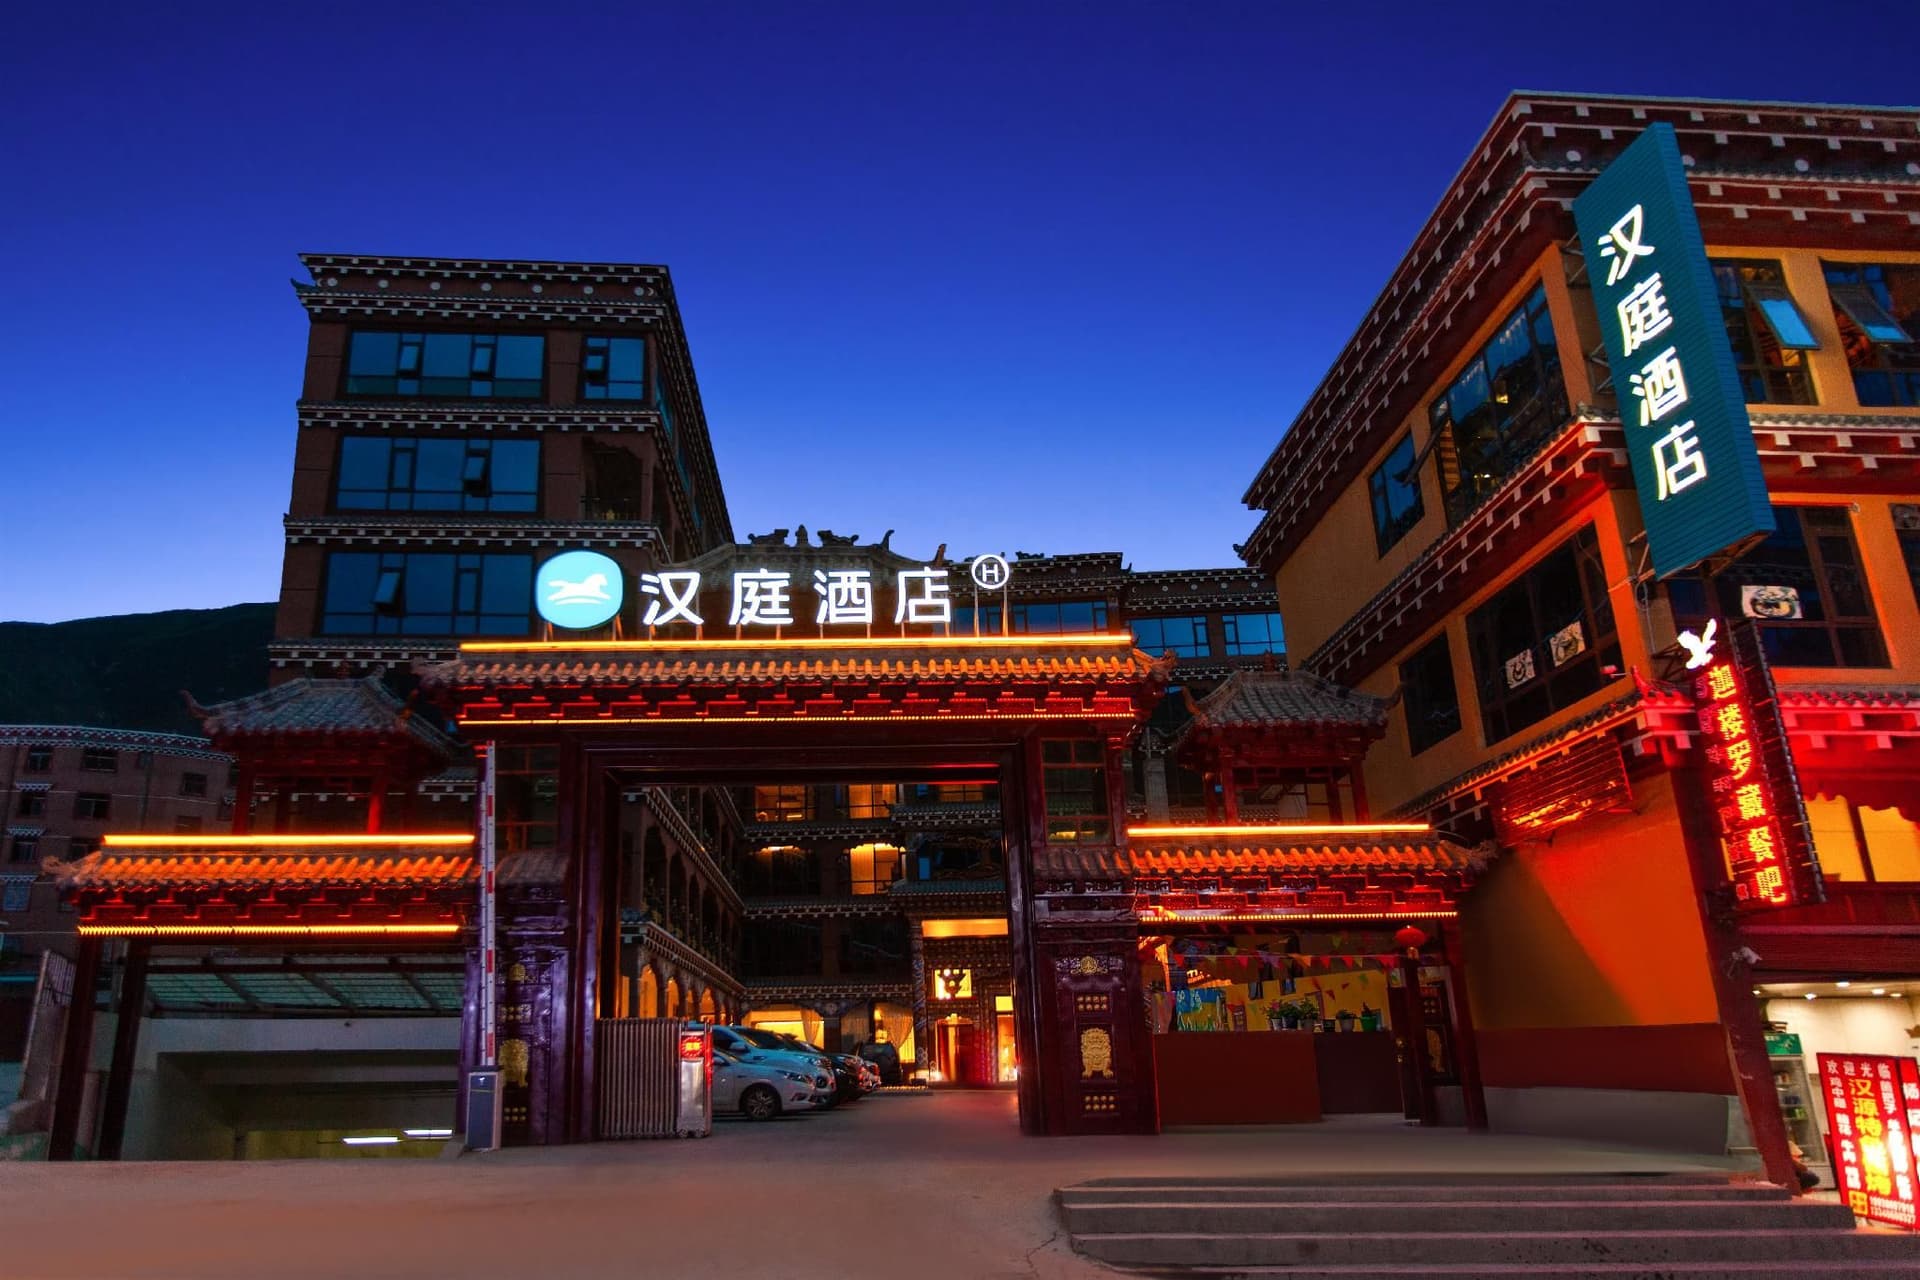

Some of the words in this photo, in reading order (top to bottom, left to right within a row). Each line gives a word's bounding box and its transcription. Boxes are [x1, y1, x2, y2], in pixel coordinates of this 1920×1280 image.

[1598, 204, 1707, 501] 汉庭酒店
[641, 568, 951, 625] 汉庭酒店
[1826, 1060, 1891, 1079] 欢迎光临
[1849, 1078, 1891, 1195] 汉源特烤
